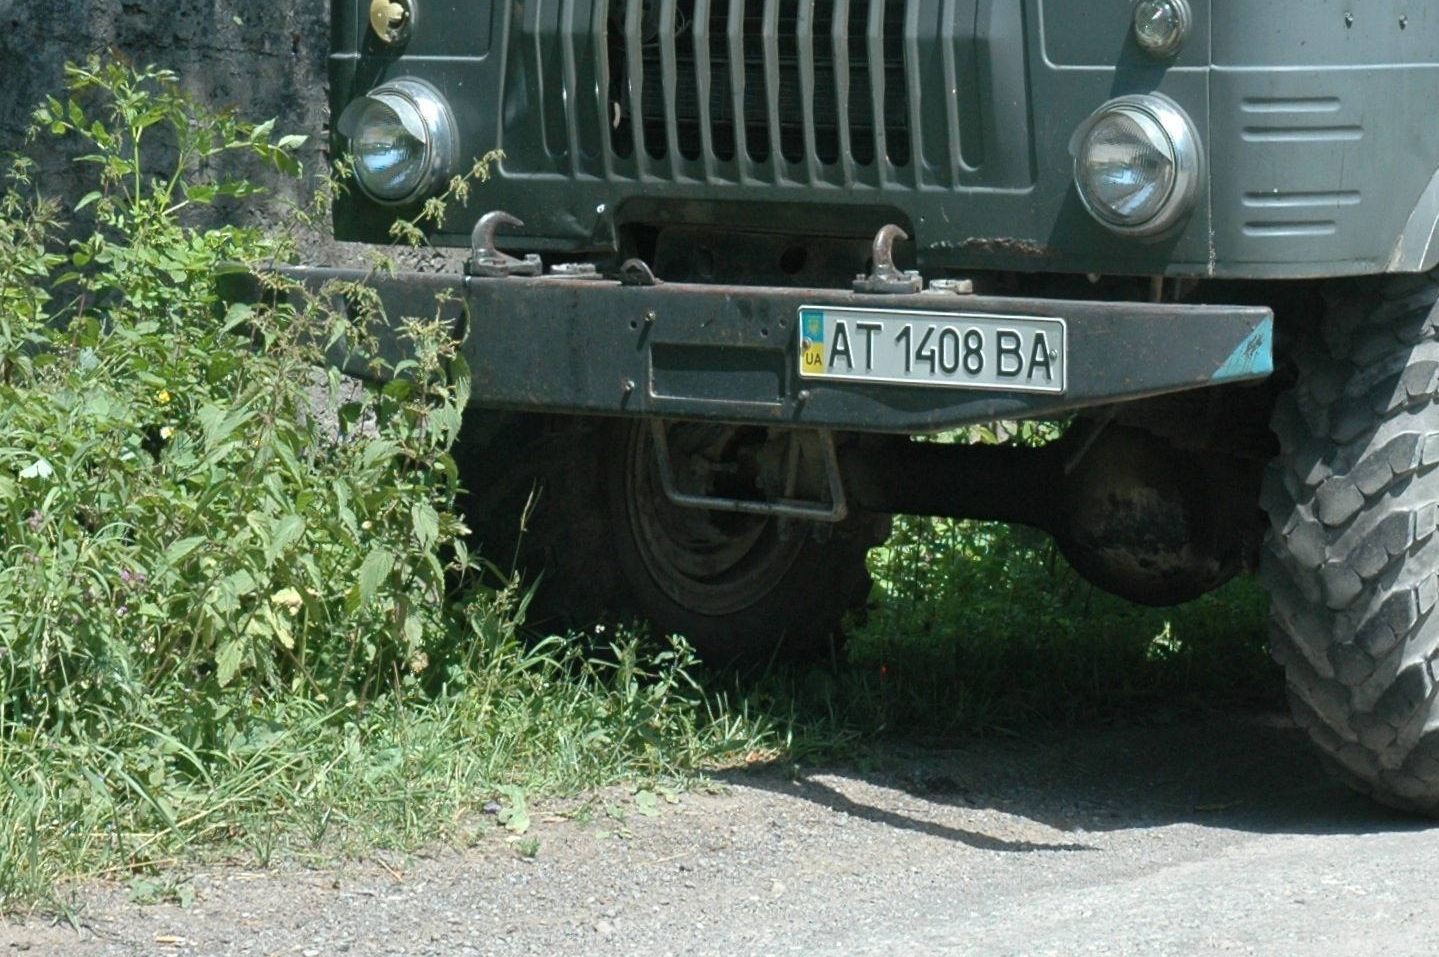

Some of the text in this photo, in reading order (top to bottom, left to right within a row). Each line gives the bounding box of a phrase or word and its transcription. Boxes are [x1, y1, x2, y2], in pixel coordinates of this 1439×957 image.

[805, 352, 822, 366] UA
[828, 320, 1054, 380] AT 1408 BA
